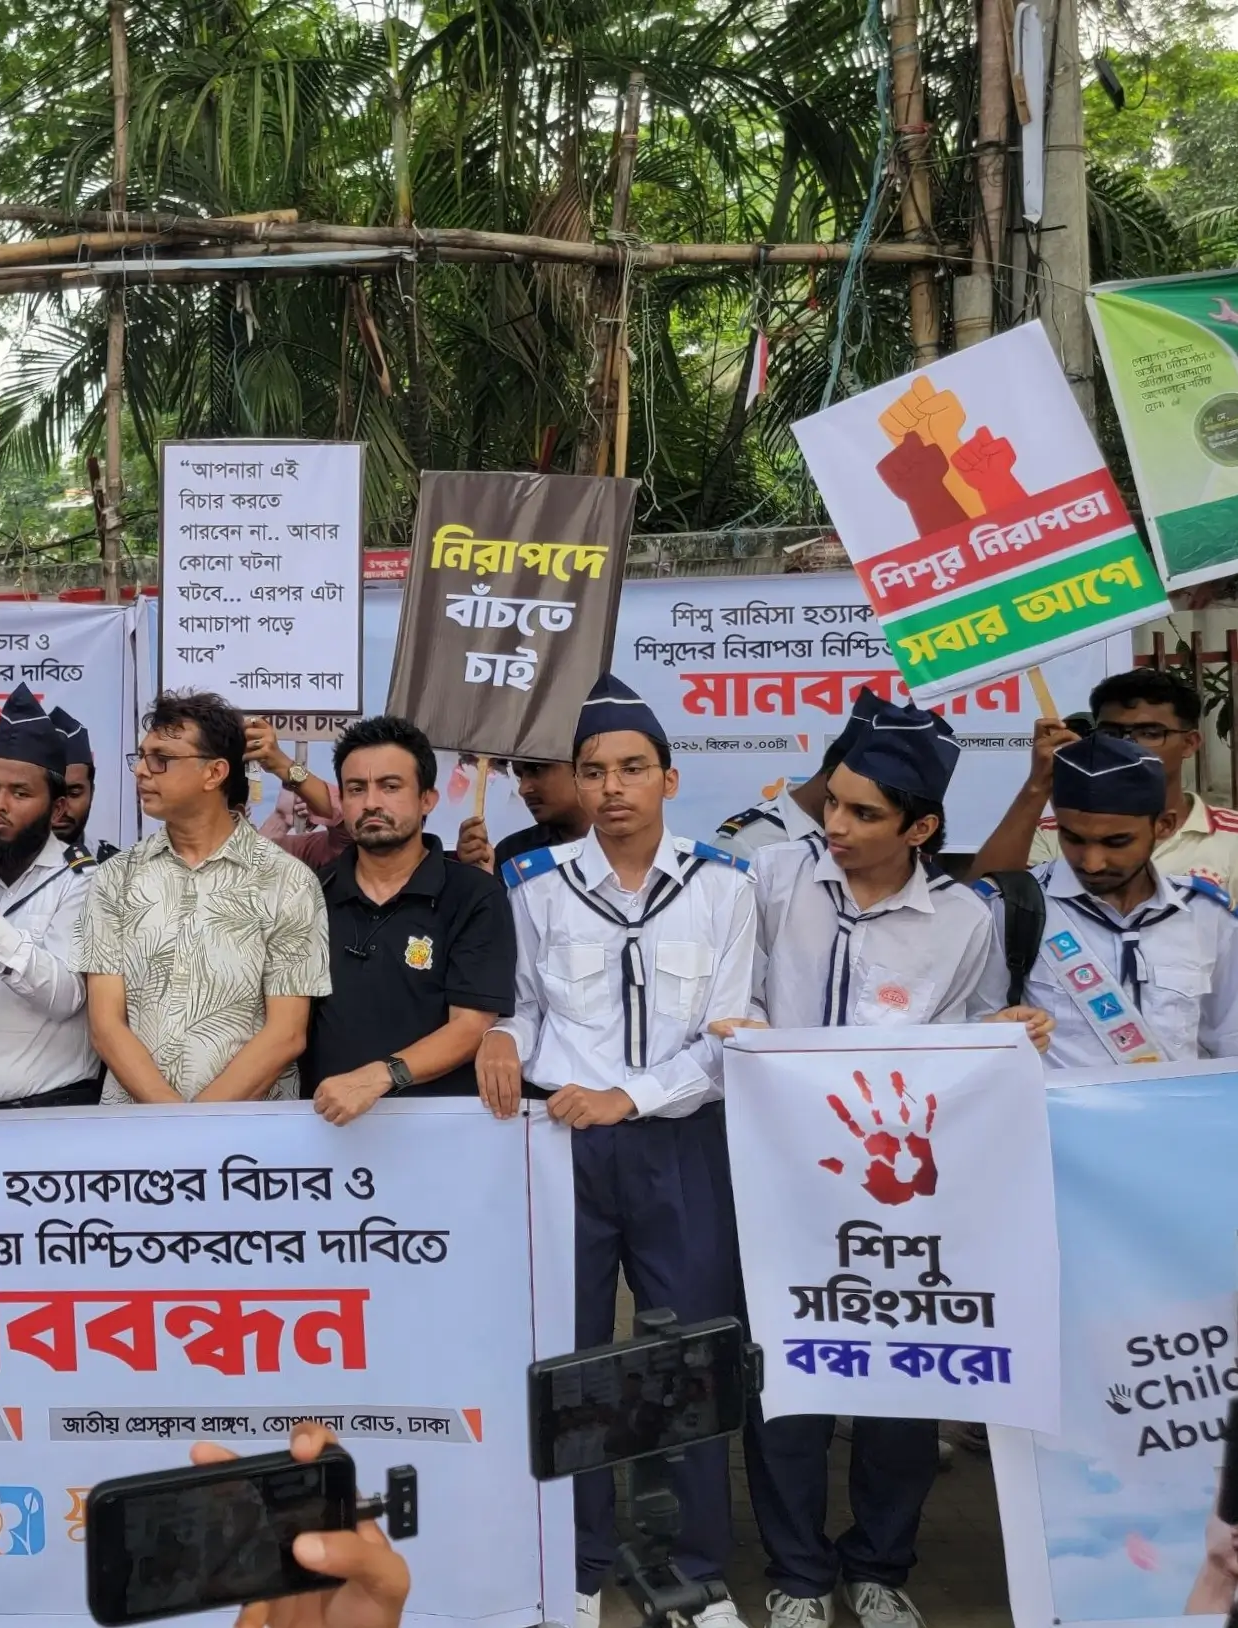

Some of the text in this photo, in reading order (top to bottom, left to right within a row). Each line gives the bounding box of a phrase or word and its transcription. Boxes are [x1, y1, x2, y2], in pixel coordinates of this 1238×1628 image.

[180, 458, 299, 483] “আপনারা এই
[179, 487, 282, 512] বিচার করতে
[179, 521, 340, 544] পারবেন না.. আবার
[870, 490, 1111, 599] শিশুর নিরাপত্তা
[179, 550, 282, 574] কোনো ঘটনা
[431, 523, 609, 582] নিরাপদে
[250, 581, 303, 603] এরপর
[310, 580, 344, 602] এটা
[178, 613, 295, 637] ধামাচাপা পড়ে
[445, 582, 577, 637] বাঁচতে
[671, 601, 713, 633] শিশু
[720, 603, 794, 626] রামিসা
[896, 556, 1145, 667] সবার আগে
[634, 638, 715, 667] শিশুদের
[722, 636, 814, 661] নিরাপত্তা
[21, 660, 85, 683] দাবিতে
[229, 665, 344, 692] -রামিসার বাবা
[464, 645, 539, 692] চাই
[706, 738, 739, 750] বিকেল
[743, 739, 787, 749] ৩.০০টা
[5, 1165, 207, 1207] হত্যাকাণ্ডের
[220, 1155, 331, 1202] বিচার
[346, 1167, 376, 1200] ও
[35, 1220, 307, 1271] নিশ্চিতকরণের
[318, 1218, 450, 1265] দাবিতে
[836, 1220, 952, 1287] শিশু
[790, 1276, 995, 1329] সহিংসতা
[1126, 1325, 1228, 1367] Stop
[784, 1339, 1012, 1386] বন্ধ করো
[62, 1411, 120, 1435] জাতীয়
[126, 1416, 196, 1438] প্রেসক্লাব
[201, 1416, 256, 1435] প্রাঙ্গণ,
[351, 1415, 402, 1434] রোড,
[408, 1416, 451, 1435] ঢাকা
